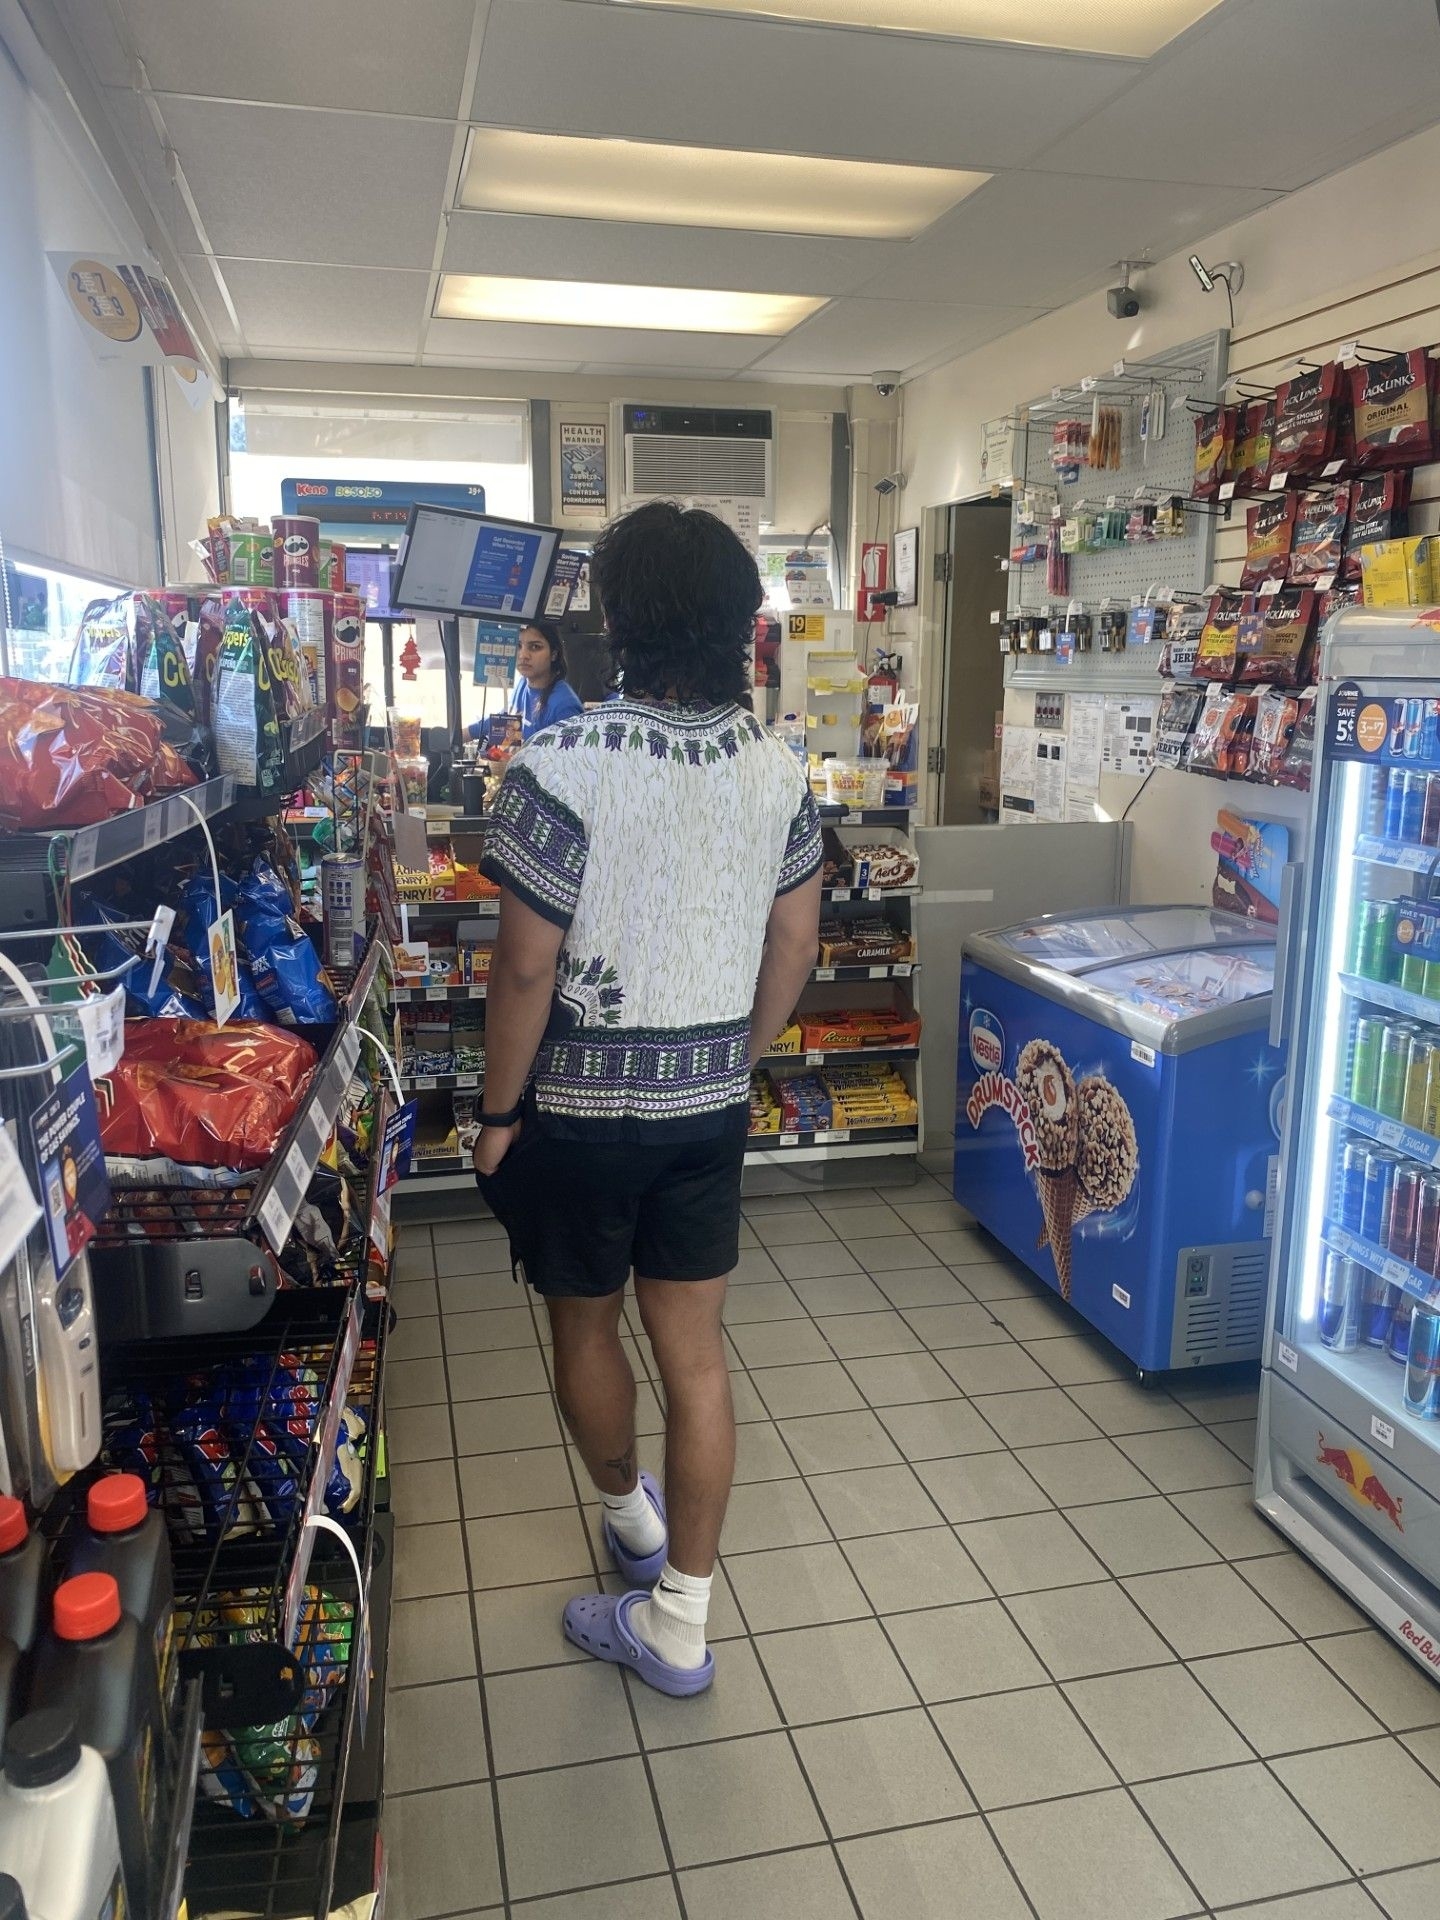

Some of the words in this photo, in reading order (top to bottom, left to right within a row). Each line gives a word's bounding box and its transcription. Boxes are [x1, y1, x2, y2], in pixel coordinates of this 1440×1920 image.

[1366, 402, 1410, 421] ORIGINAL
[563, 427, 602, 436] HEALTH
[562, 496, 605, 504] FORMALDEHYDE
[283, 554, 309, 568] PRINGLES
[791, 616, 805, 633] 19
[1336, 708, 1356, 717] SAVE
[1360, 720, 1367, 734] 3
[861, 868, 868, 877] 3
[398, 886, 432, 901] ENRY!
[435, 886, 446, 901] 2
[857, 947, 892, 958] CARAMILK
[769, 1041, 795, 1053] NRY!
[967, 1071, 1040, 1171] DRUMSTICK
[1407, 1275, 1424, 1292] GAR.
[1398, 1620, 1426, 1646] Red
